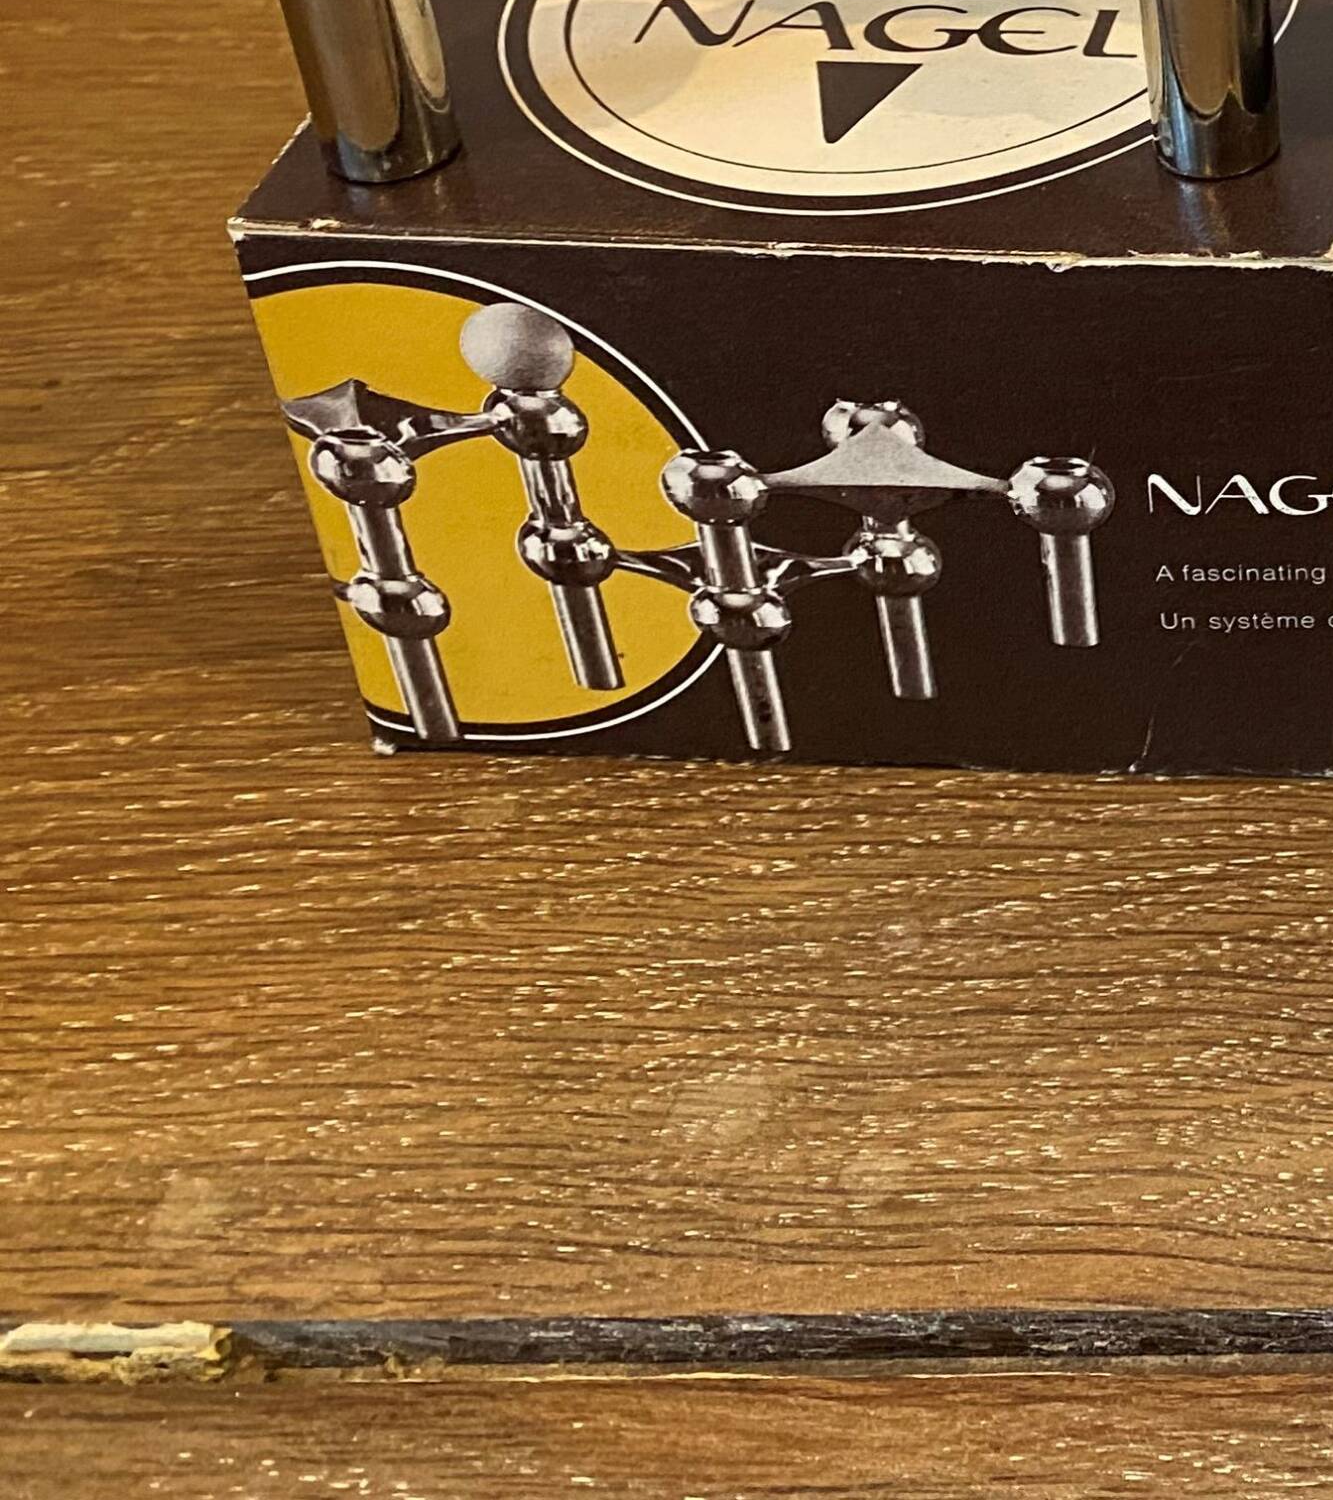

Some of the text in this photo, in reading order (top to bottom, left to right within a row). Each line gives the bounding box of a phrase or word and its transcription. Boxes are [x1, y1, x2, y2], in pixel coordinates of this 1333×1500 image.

[1155, 564, 1175, 583] A
[1182, 563, 1327, 585] fascinating
[1160, 612, 1196, 630] Un
[1208, 612, 1315, 634] système
